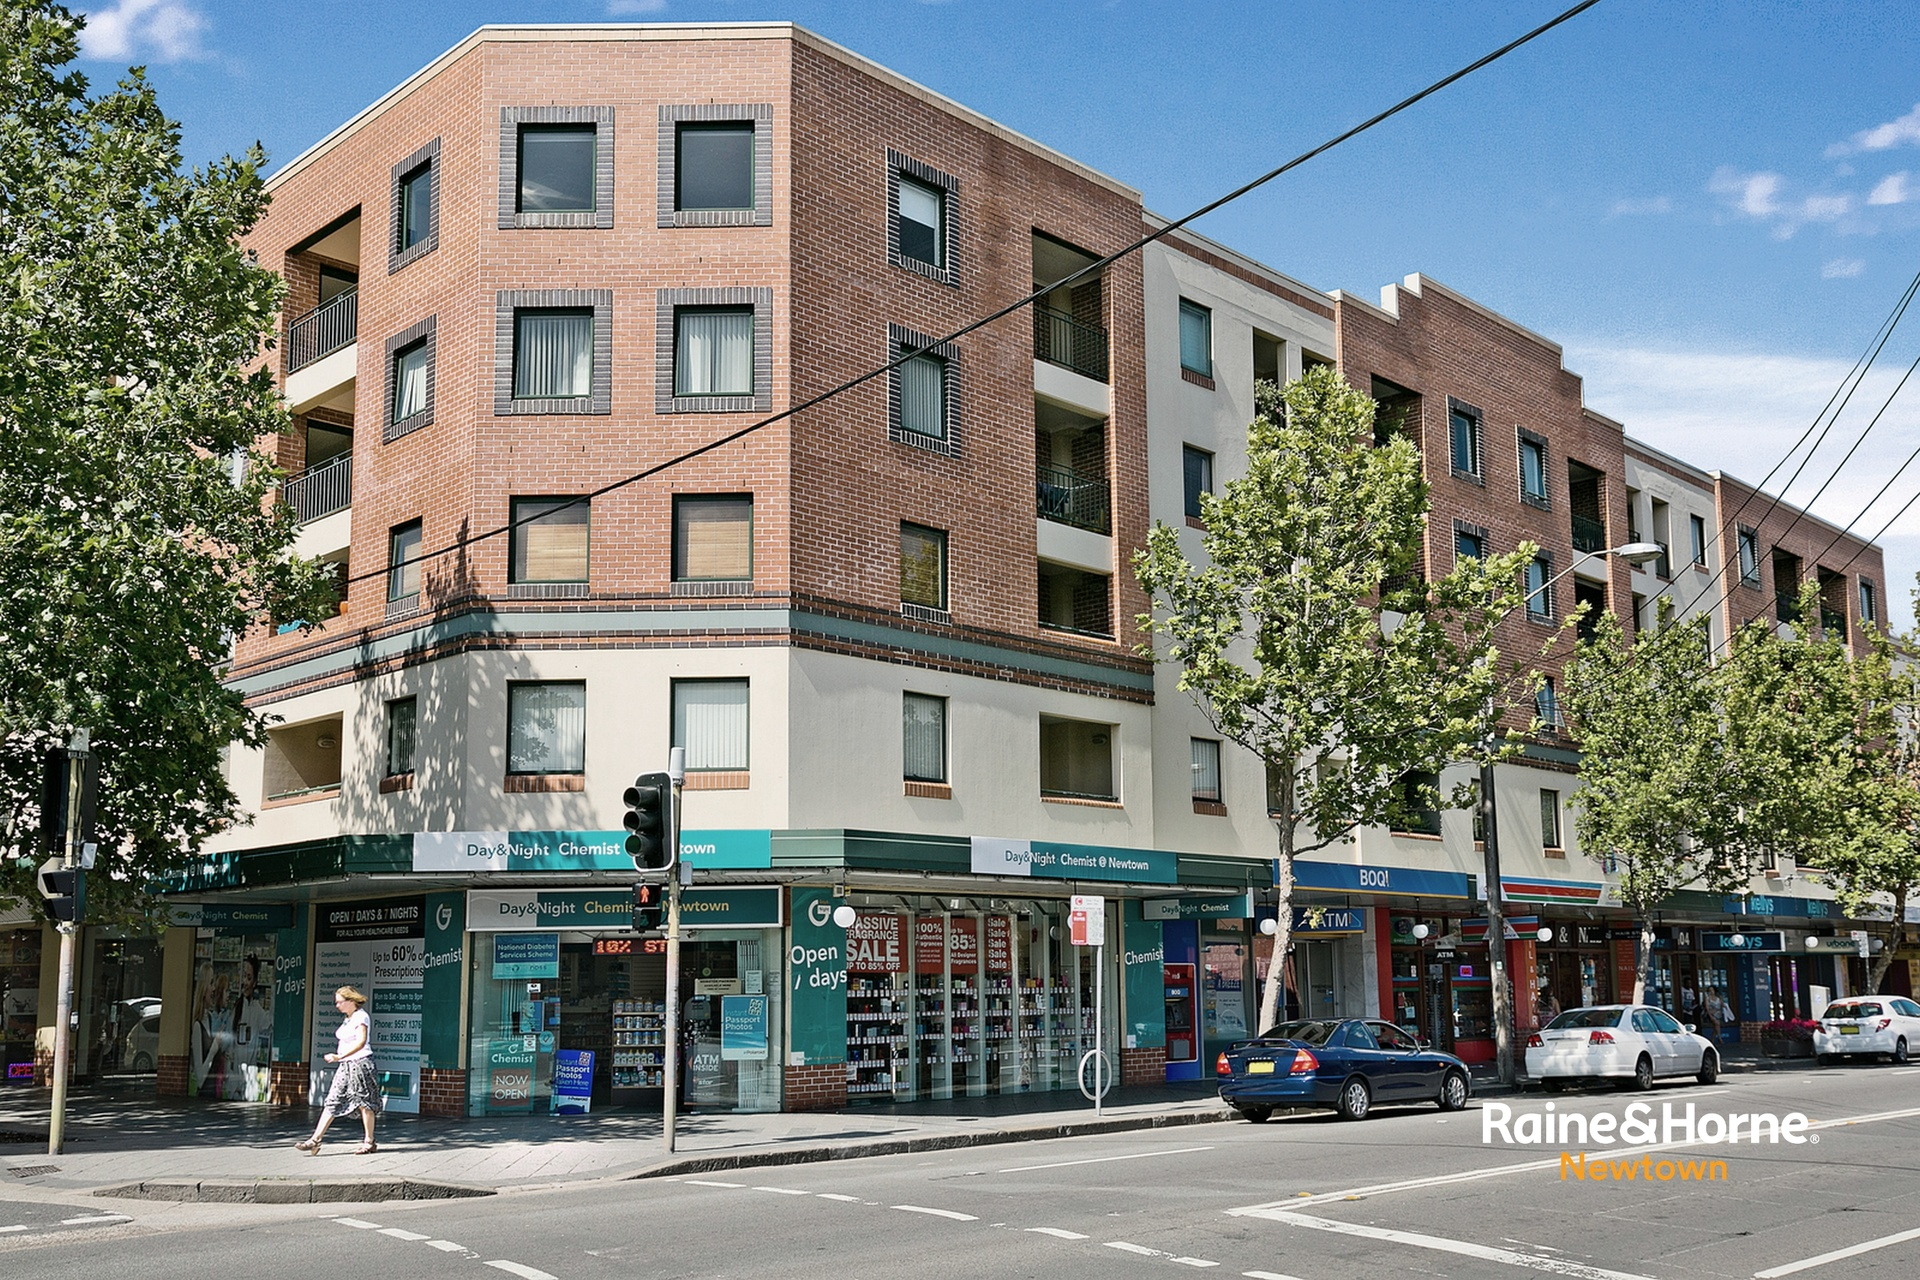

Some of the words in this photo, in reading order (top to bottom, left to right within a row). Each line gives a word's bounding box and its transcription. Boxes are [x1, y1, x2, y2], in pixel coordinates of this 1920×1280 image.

[467, 843, 550, 859] Day&Night
[559, 842, 620, 856] Chemist
[680, 843, 716, 854] town
[1005, 850, 1056, 867] Day&Night
[1060, 853, 1097, 868] Chemist
[1099, 856, 1107, 867] @
[1108, 857, 1149, 871] Newtown
[500, 902, 576, 917] Day&Night
[1201, 903, 1230, 912] Chemist
[232, 911, 268, 920] Chemist
[329, 911, 350, 923] OPEN
[356, 909, 376, 922] DAYS
[377, 909, 383, 920] &
[390, 906, 419, 919] NIGHTS
[915, 923, 943, 933] 100%
[596, 939, 631, 953] 10%
[847, 940, 900, 962] SALE
[372, 952, 381, 964] Up
[383, 954, 391, 962] to
[391, 945, 417, 962] 60%
[424, 948, 463, 969] Chemist
[791, 945, 838, 968] Open
[1125, 949, 1164, 966] Chemist
[1437, 951, 1455, 959] ATM
[276, 955, 302, 974] Open
[886, 962, 901, 970] OFF
[375, 966, 424, 980] Prescriptions
[809, 967, 848, 990] days
[276, 980, 282, 995] 7
[284, 976, 306, 996] days
[725, 1016, 761, 1024] Passport
[725, 1023, 754, 1031] Photos
[491, 1053, 534, 1064] Chemist
[694, 1054, 720, 1065] ATM
[10, 1065, 33, 1076] OPE
[556, 1064, 591, 1073] Passport
[495, 1075, 529, 1086] NOW
[556, 1071, 583, 1080] Photos
[494, 1089, 528, 1100] OPEN
